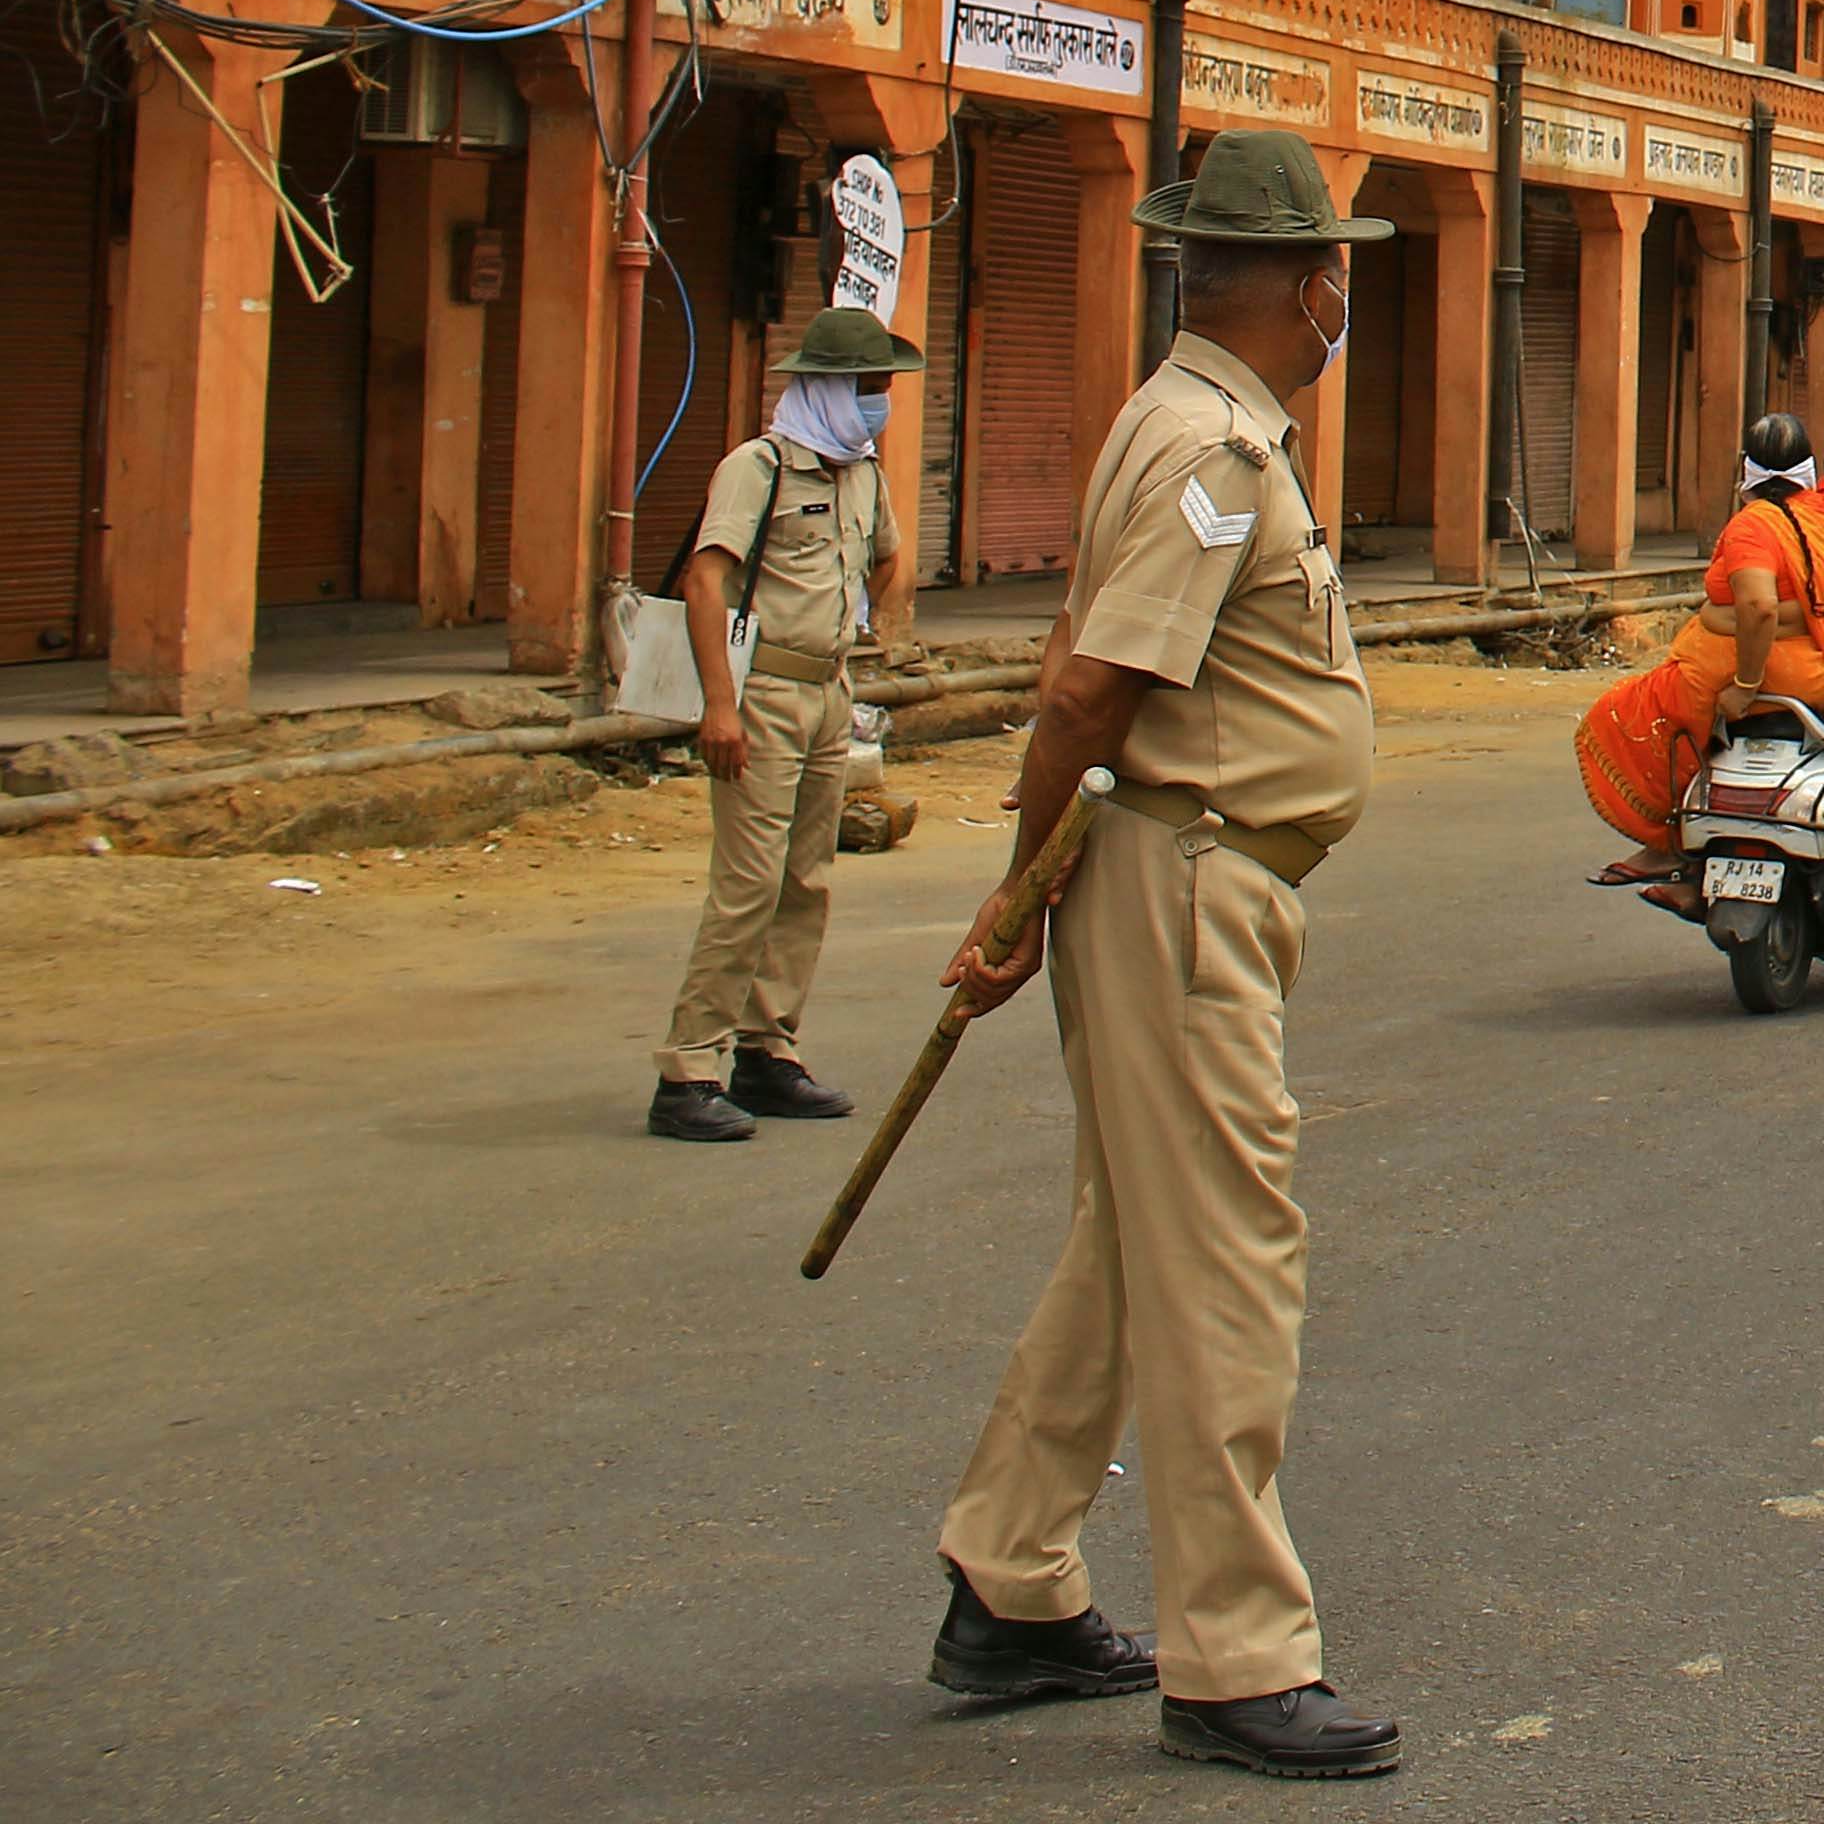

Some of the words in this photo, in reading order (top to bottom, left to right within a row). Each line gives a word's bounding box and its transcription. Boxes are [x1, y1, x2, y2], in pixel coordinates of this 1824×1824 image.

[851, 168, 872, 195] SHOP
[838, 194, 856, 223] 372
[856, 203, 870, 230] TO
[1727, 861, 1744, 876] RJ
[1749, 863, 1763, 877] 14
[1741, 883, 1774, 900] 8238
